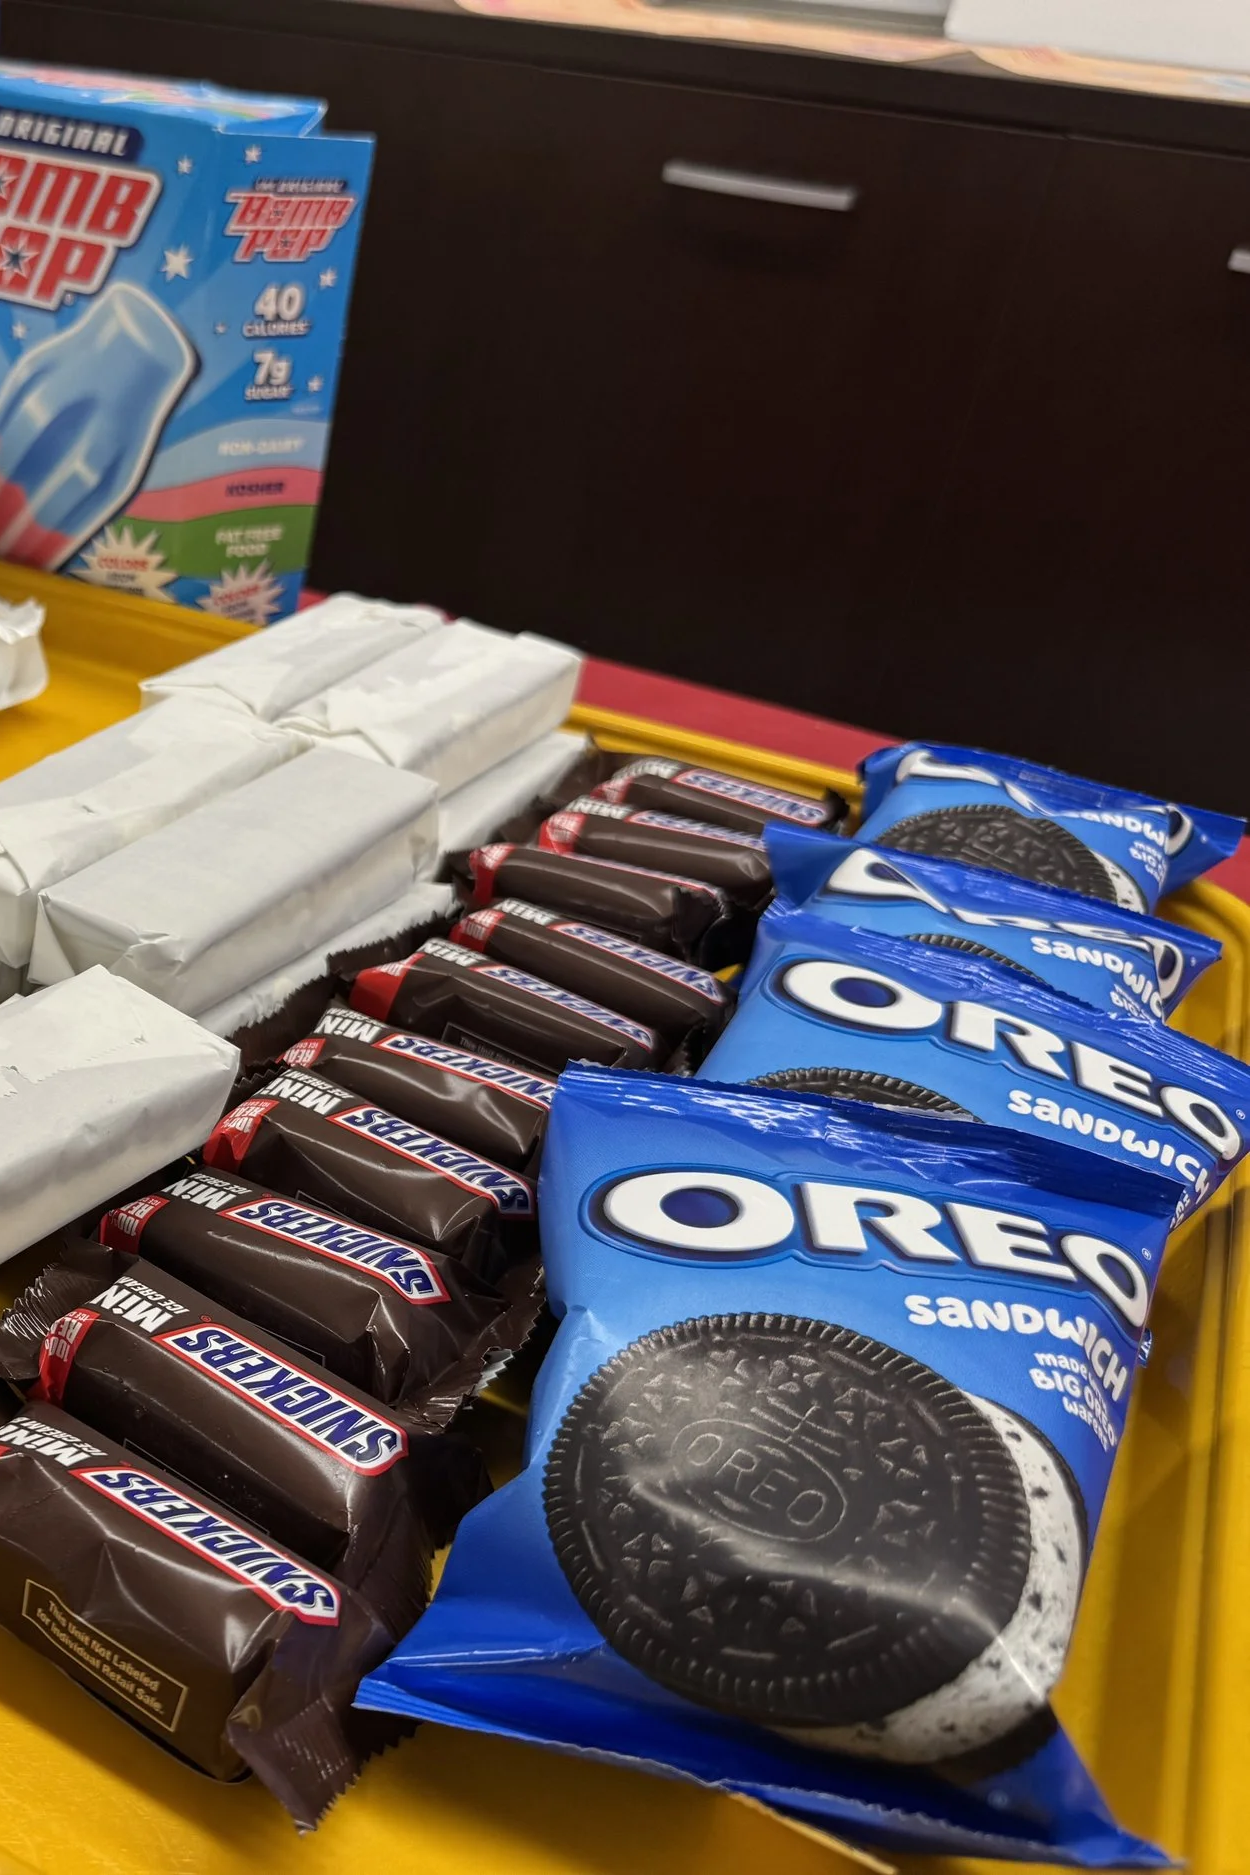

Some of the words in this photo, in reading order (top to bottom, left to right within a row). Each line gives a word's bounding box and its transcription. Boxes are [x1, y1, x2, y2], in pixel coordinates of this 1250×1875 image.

[224, 225, 336, 263] POP
[226, 191, 356, 229] BOMB
[243, 321, 310, 337] CALORIES
[255, 284, 304, 321] 40
[253, 351, 291, 386] 7g
[564, 923, 725, 1003] SNICKERS
[314, 1014, 384, 1044] MiN
[482, 963, 654, 1050] SNICKERS
[392, 1033, 556, 1106] NICKERS
[783, 960, 1242, 1160] OREO
[161, 1177, 238, 1211] MiN
[349, 1106, 533, 1214] SNICKERS
[239, 1200, 435, 1297] SNICKERS
[603, 1170, 1151, 1329] OREO
[86, 1284, 175, 1333] MiN
[170, 1329, 400, 1464] SNICKERS
[1028, 1367, 1082, 1399] BIG
[686, 1432, 827, 1527] OREO
[92, 1469, 336, 1618] SNICKERS
[35, 1606, 52, 1628] for
[50, 1622, 102, 1669] Individual
[101, 1662, 136, 1695] Retail
[134, 1687, 166, 1716] Sale.
[48, 1600, 68, 1628] This
[67, 1621, 91, 1647] Unit
[89, 1639, 113, 1662] Not
[112, 1653, 161, 1693] Labeled
